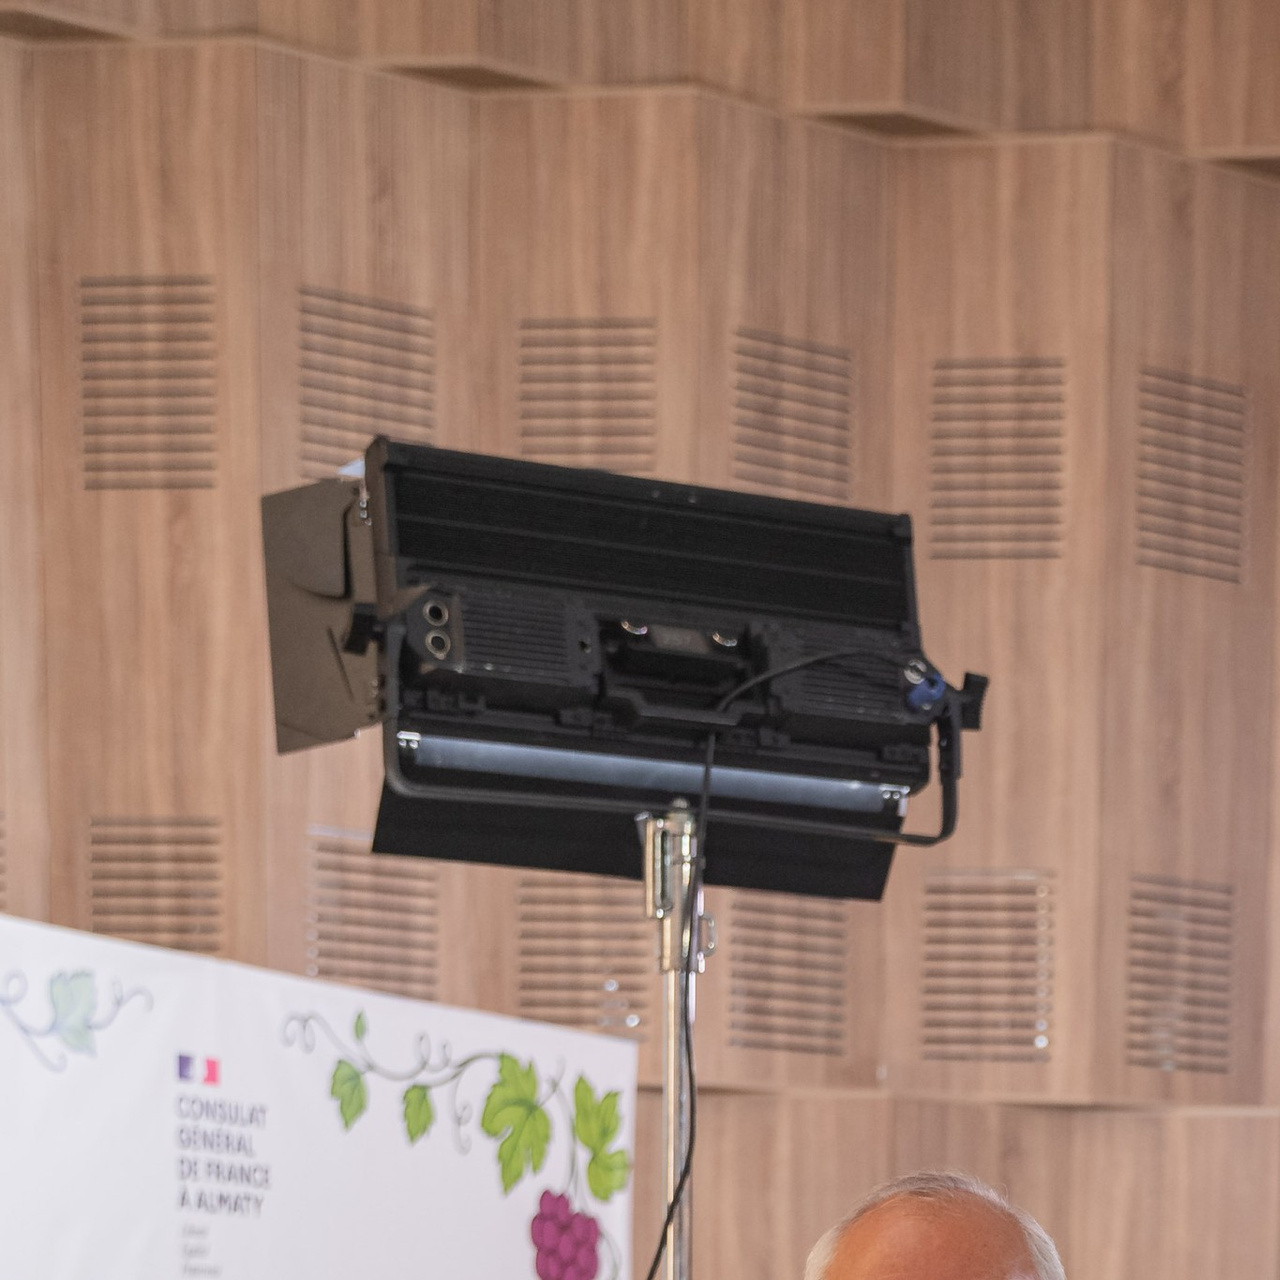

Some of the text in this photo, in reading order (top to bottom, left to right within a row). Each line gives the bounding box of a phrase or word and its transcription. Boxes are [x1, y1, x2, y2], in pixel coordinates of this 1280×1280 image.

[178, 1098, 267, 1128] CONSULAT
[179, 1158, 271, 1188] DE FRANCE
[197, 1192, 264, 1216] ALMATY
